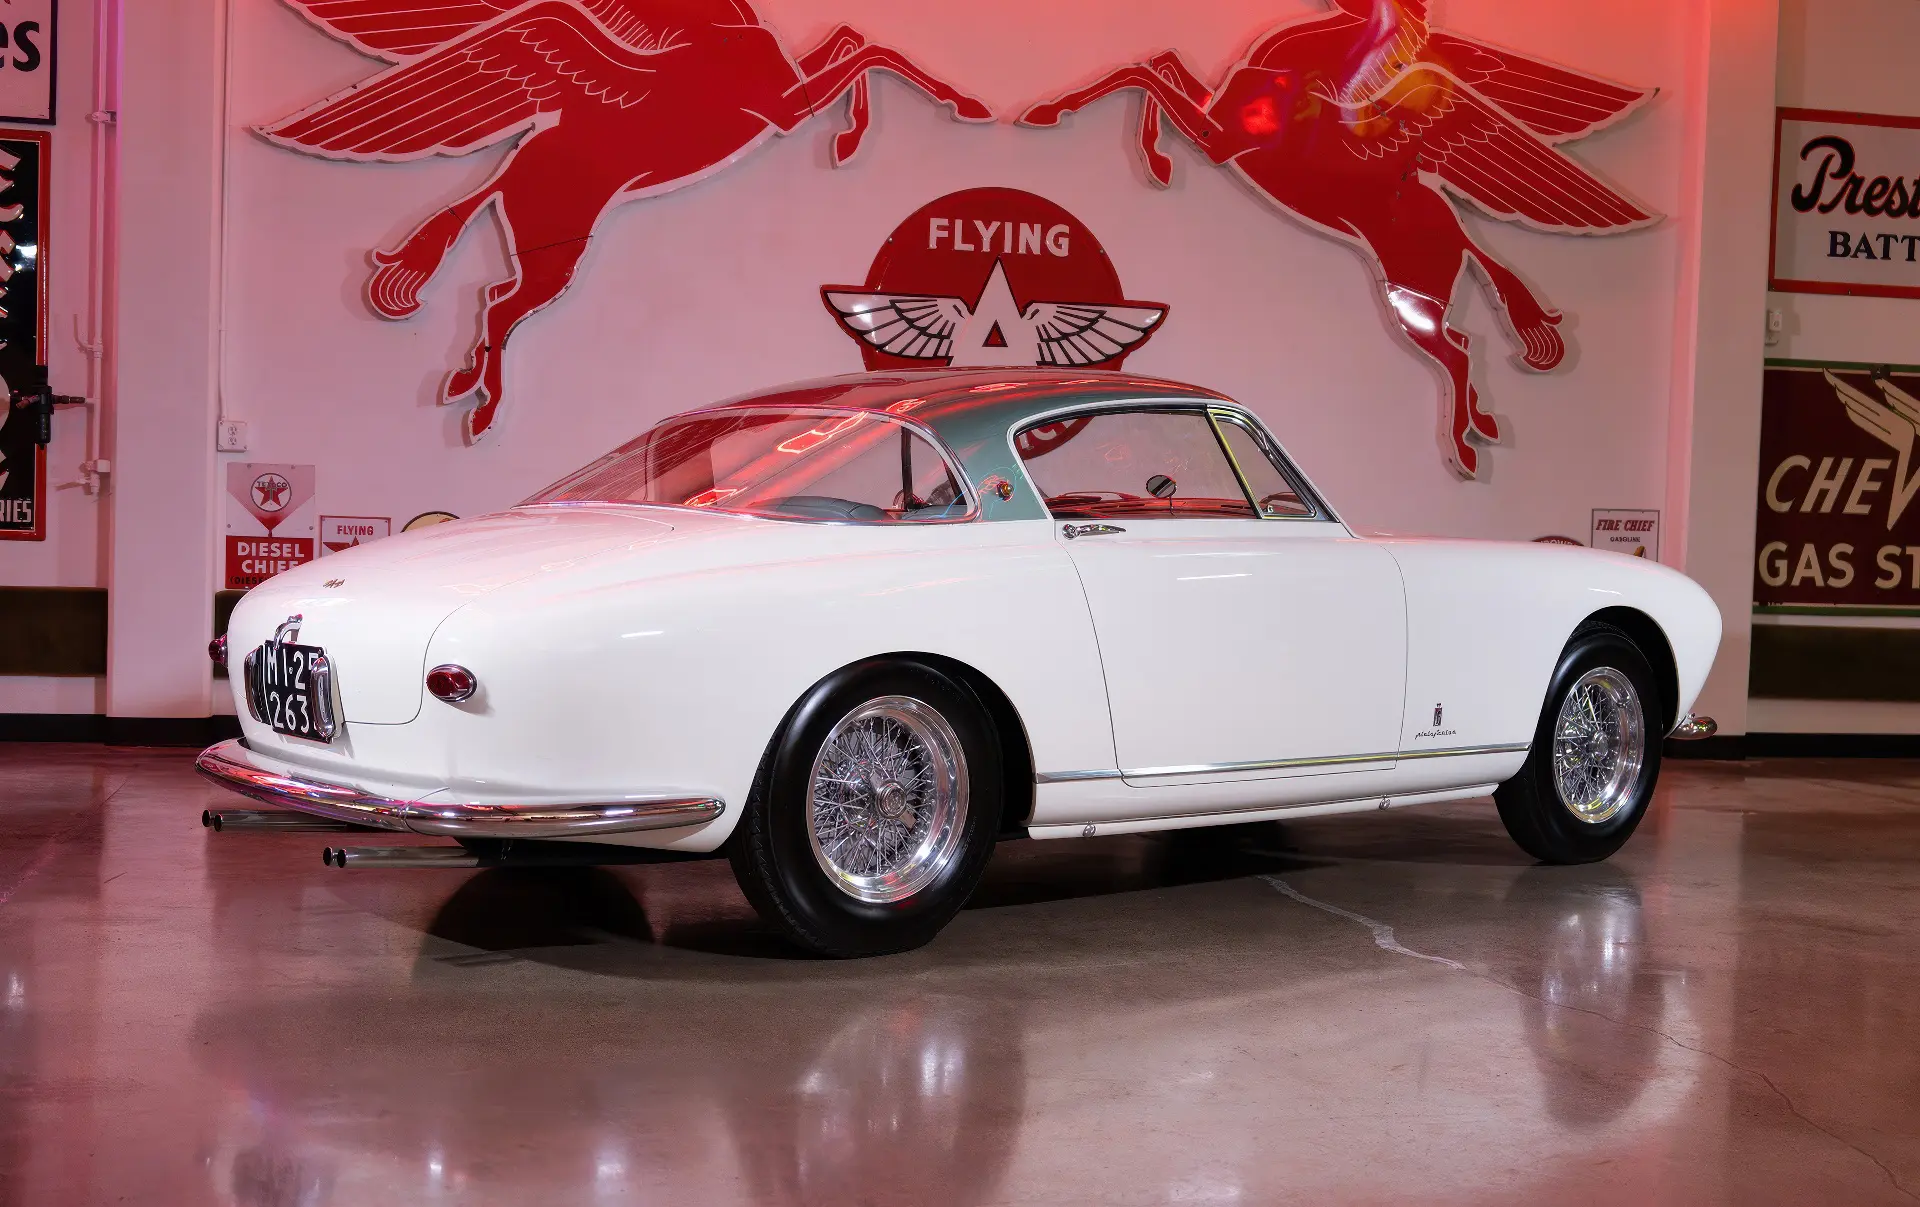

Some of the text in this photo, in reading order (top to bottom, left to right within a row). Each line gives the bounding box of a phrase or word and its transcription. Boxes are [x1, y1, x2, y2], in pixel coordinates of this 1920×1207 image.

[927, 217, 1070, 257] FLYING
[1826, 230, 1920, 262] BATT
[337, 524, 374, 536] FLYING
[1595, 519, 1655, 532] FIRE CHIEF
[237, 541, 305, 558] DIESEL
[1758, 541, 1855, 588] GAS
[269, 691, 317, 733] 263
